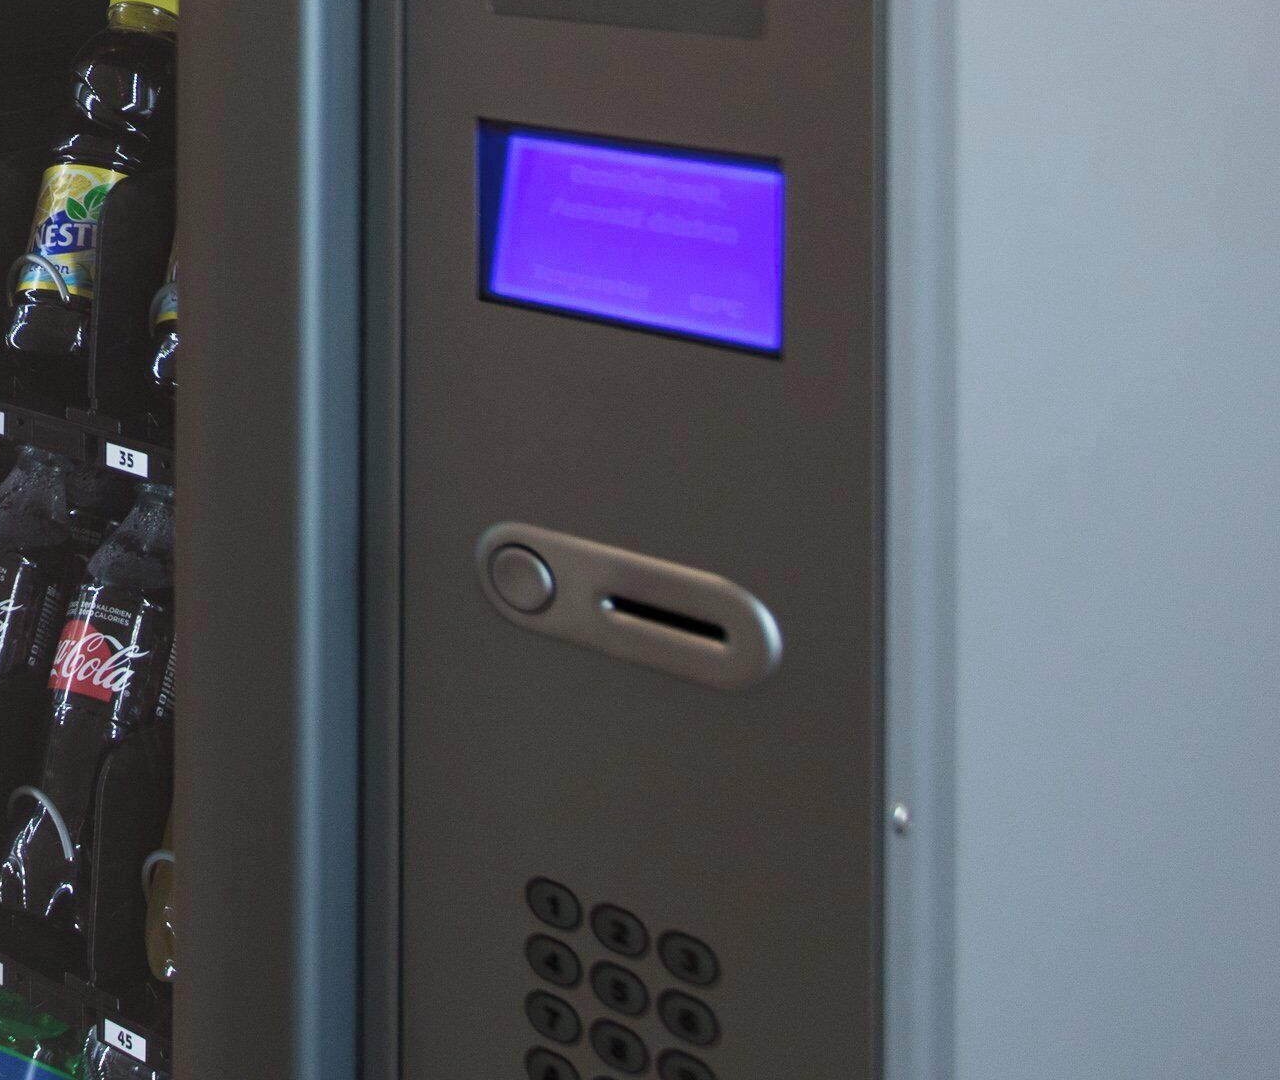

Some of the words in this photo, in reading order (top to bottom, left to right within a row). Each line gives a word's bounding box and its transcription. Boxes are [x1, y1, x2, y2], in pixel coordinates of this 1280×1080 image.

[119, 450, 134, 468] 35
[94, 610, 130, 626] CALORIES
[96, 603, 132, 618] KALORIEN
[117, 1030, 133, 1050] 45
